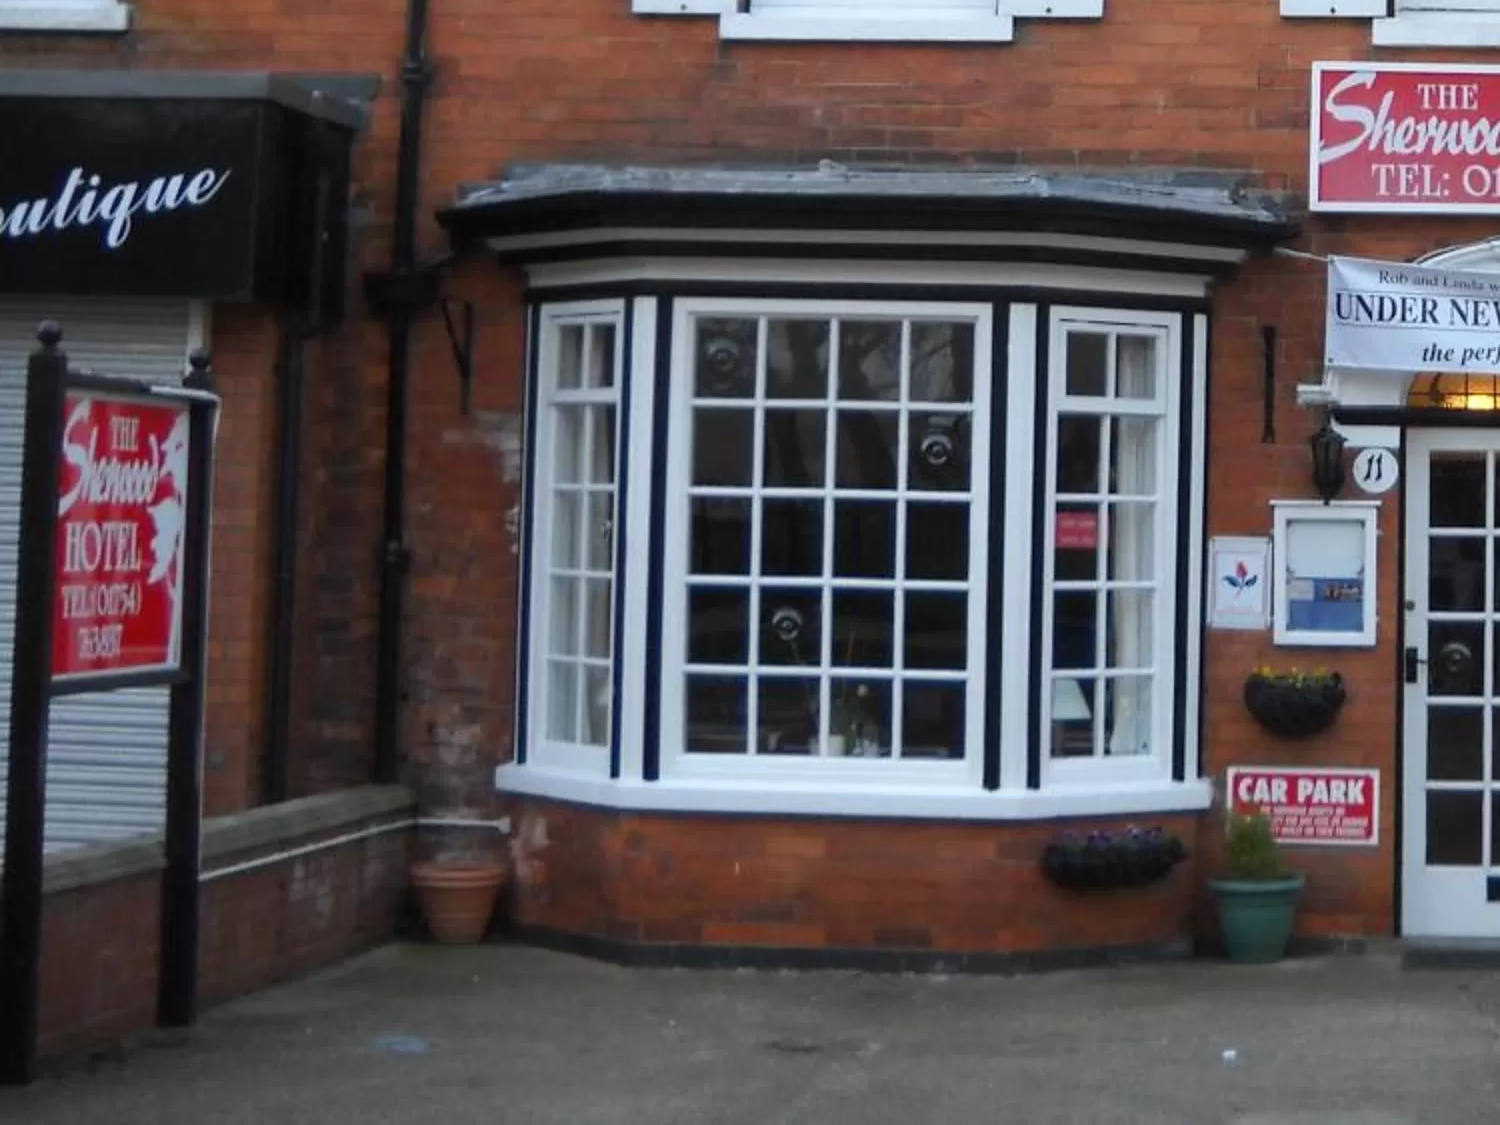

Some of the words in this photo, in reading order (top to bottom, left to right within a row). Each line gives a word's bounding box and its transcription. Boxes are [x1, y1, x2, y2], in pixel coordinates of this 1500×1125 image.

[1417, 84, 1479, 110] THE
[1372, 163, 1450, 197] TEL:
[1378, 269, 1409, 285] Rob
[1413, 274, 1439, 288] and
[1336, 292, 1439, 325] UNDER
[1422, 341, 1455, 363] the
[110, 415, 140, 452] THE
[58, 396, 160, 517] Sherwood
[1364, 453, 1384, 482] 11
[63, 521, 142, 573] HOTEL
[1238, 777, 1288, 804] CAR
[1297, 779, 1366, 805] PARK
